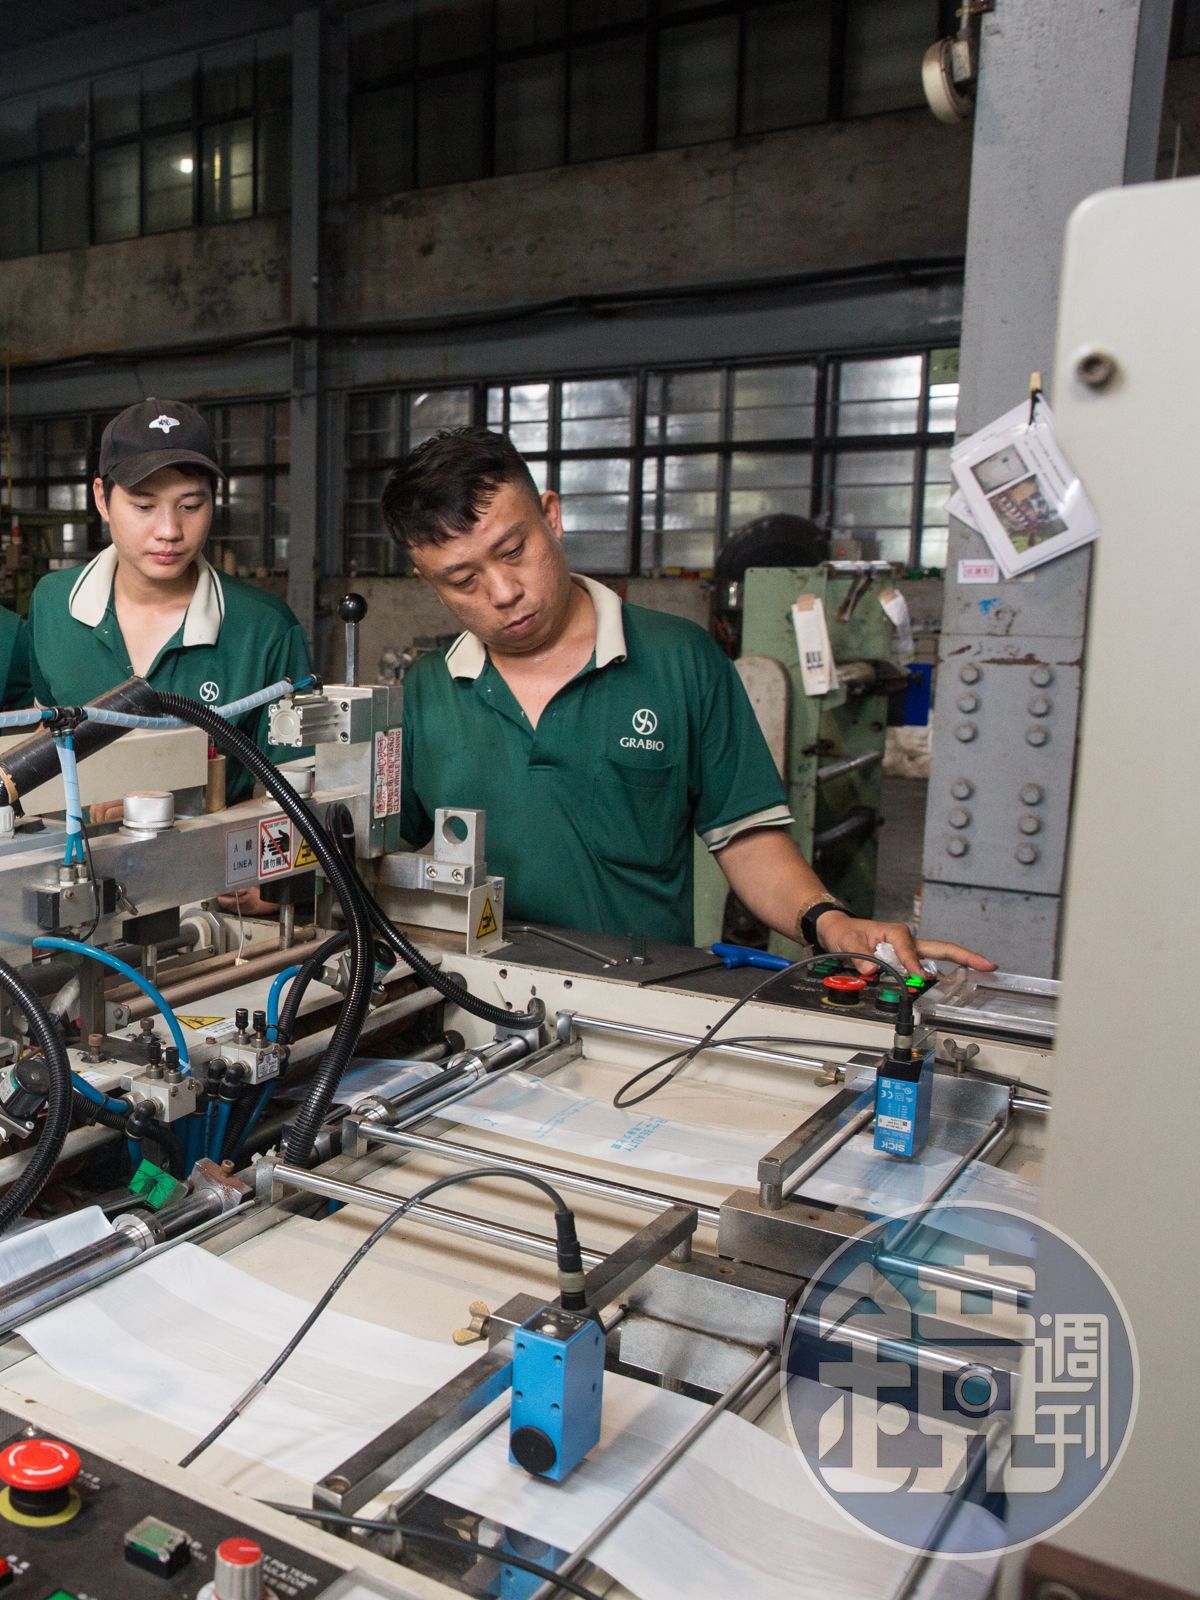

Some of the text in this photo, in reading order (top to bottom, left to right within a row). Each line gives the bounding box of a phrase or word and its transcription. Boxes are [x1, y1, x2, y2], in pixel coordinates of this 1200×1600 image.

[619, 736, 664, 751] GRABIO
[233, 860, 248, 871] LINE
[881, 1140, 906, 1152] SICK
